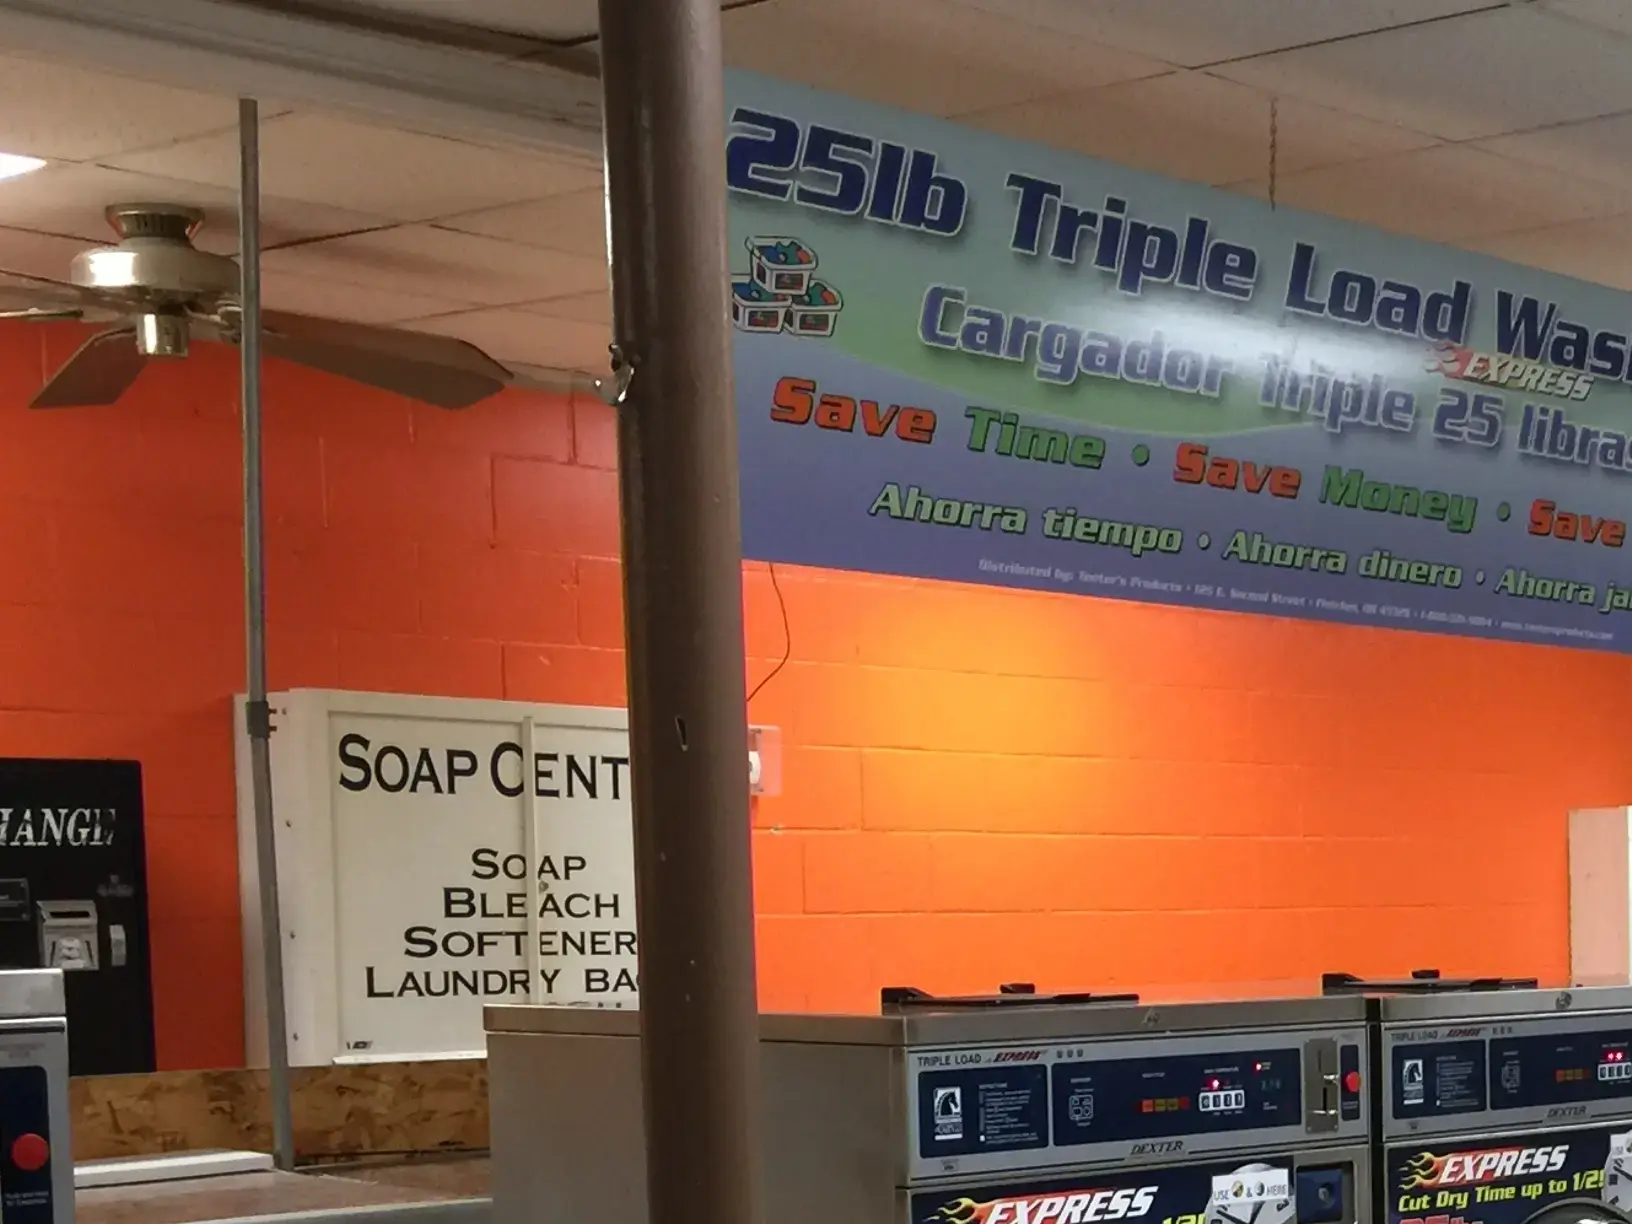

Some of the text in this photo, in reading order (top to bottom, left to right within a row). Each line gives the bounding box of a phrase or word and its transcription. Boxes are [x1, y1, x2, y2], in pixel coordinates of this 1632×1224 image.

[726, 107, 967, 237] 25lb
[1005, 172, 1259, 301] Triple
[1285, 243, 1473, 346] Load
[917, 282, 1235, 398] Cargador
[1257, 350, 1416, 433] Triple
[1433, 387, 1504, 447] 25
[1461, 354, 1596, 402] EXPRESS
[769, 375, 938, 444] Save
[964, 405, 1107, 469] Time
[1172, 440, 1302, 499] Save
[1319, 464, 1479, 534] Money
[1527, 499, 1627, 548] Save
[868, 482, 1028, 533] Ahorra
[1041, 507, 1184, 558] tiempo
[1221, 529, 1347, 575] Ahorra
[1357, 550, 1463, 590] dinero
[1493, 568, 1595, 607] Ahorra
[337, 733, 479, 795] SOAP
[470, 847, 587, 881] SOAP
[442, 886, 620, 919] BLEACH
[403, 925, 638, 959] SOFTENER
[364, 965, 639, 999] LAUNDRY BA
[916, 1054, 951, 1068] TRIPLE
[954, 1053, 983, 1066] LOAD
[1129, 1139, 1184, 1157] DEXTER
[1438, 1143, 1571, 1185] EXPRESS
[1397, 1168, 1605, 1213] Cut Dry Time up to 1/2!
